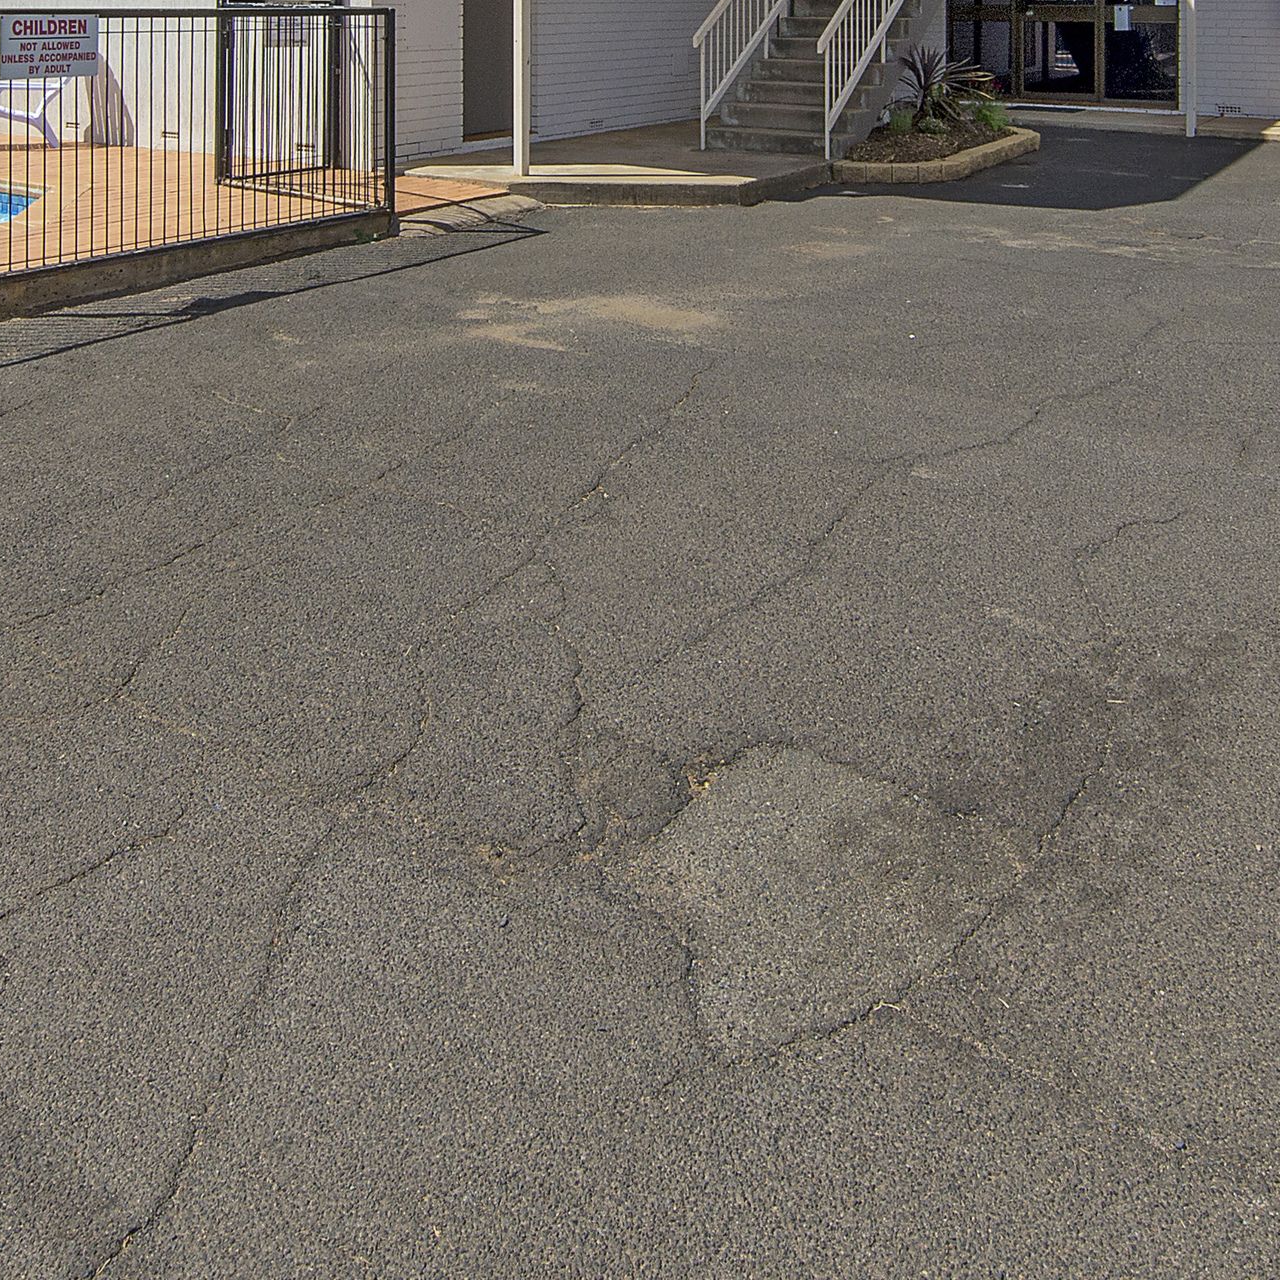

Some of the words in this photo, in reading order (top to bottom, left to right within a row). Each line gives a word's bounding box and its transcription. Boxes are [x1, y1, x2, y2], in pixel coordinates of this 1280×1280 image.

[11, 19, 88, 36] CHILDREN
[20, 42, 38, 52] NOT
[41, 41, 81, 51] ALLOWED
[1, 54, 35, 64] UNLESS
[38, 52, 97, 63] ACCOMPANIED
[28, 65, 40, 74] BY
[44, 64, 72, 74] ADULT
